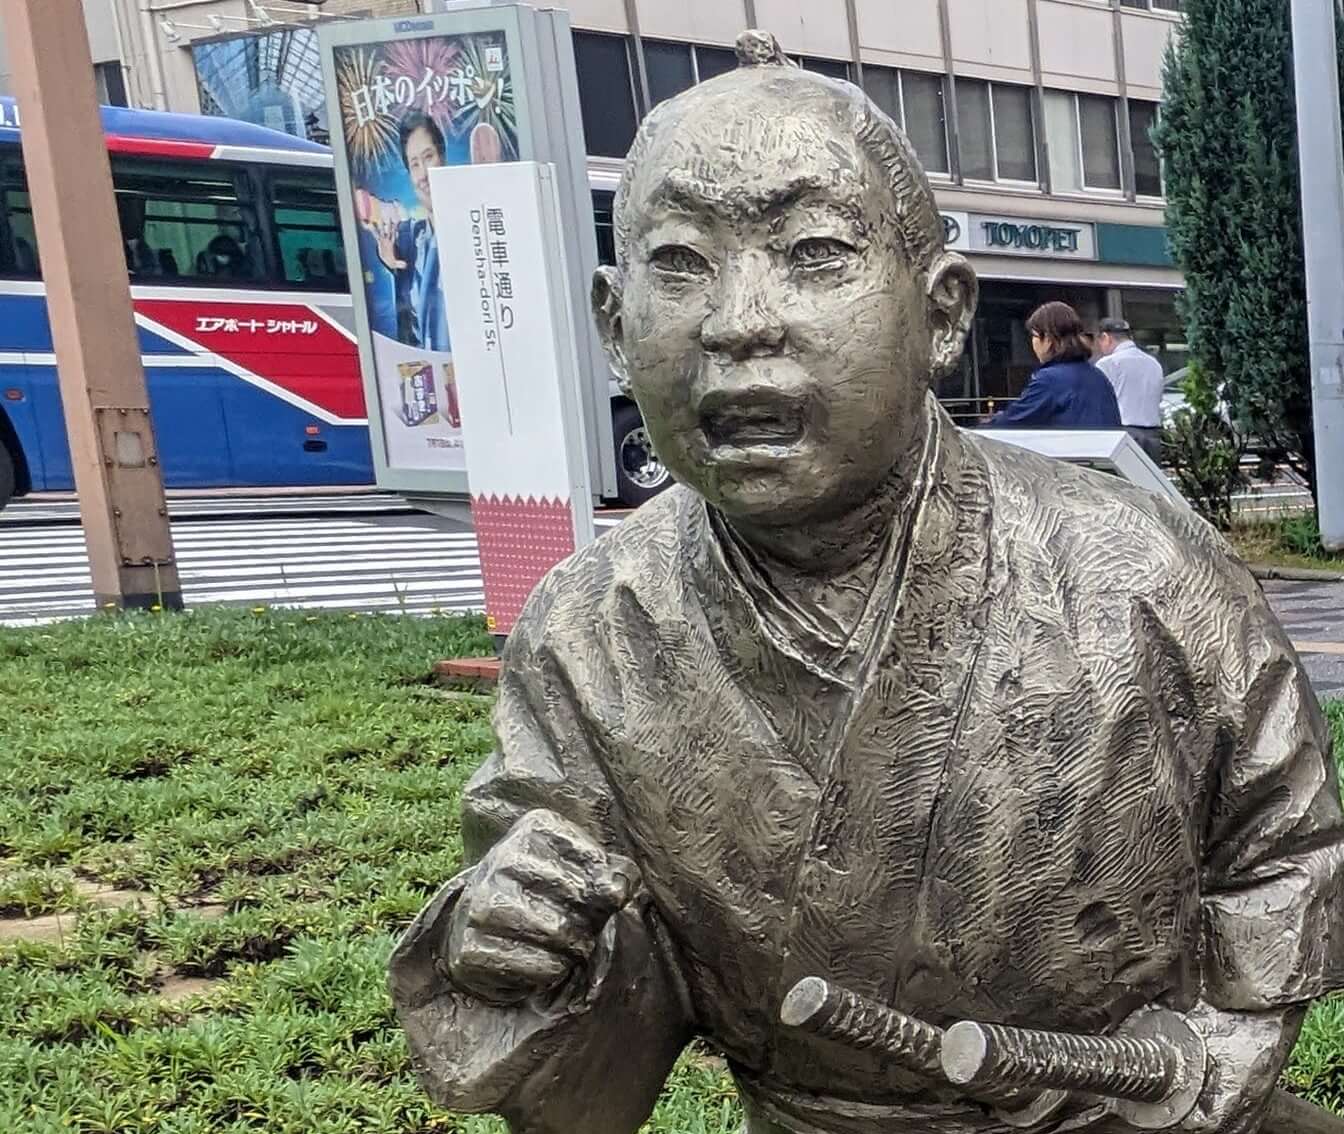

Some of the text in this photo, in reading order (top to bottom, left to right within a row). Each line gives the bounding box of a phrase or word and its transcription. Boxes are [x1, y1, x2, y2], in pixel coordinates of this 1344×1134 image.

[350, 63, 505, 127] 日本のイッポン!
[981, 221, 1082, 250] TOYOPET
[470, 209, 496, 352] Densha-dori St.
[486, 207, 514, 330] 電車通り
[266, 319, 318, 335] シャトル
